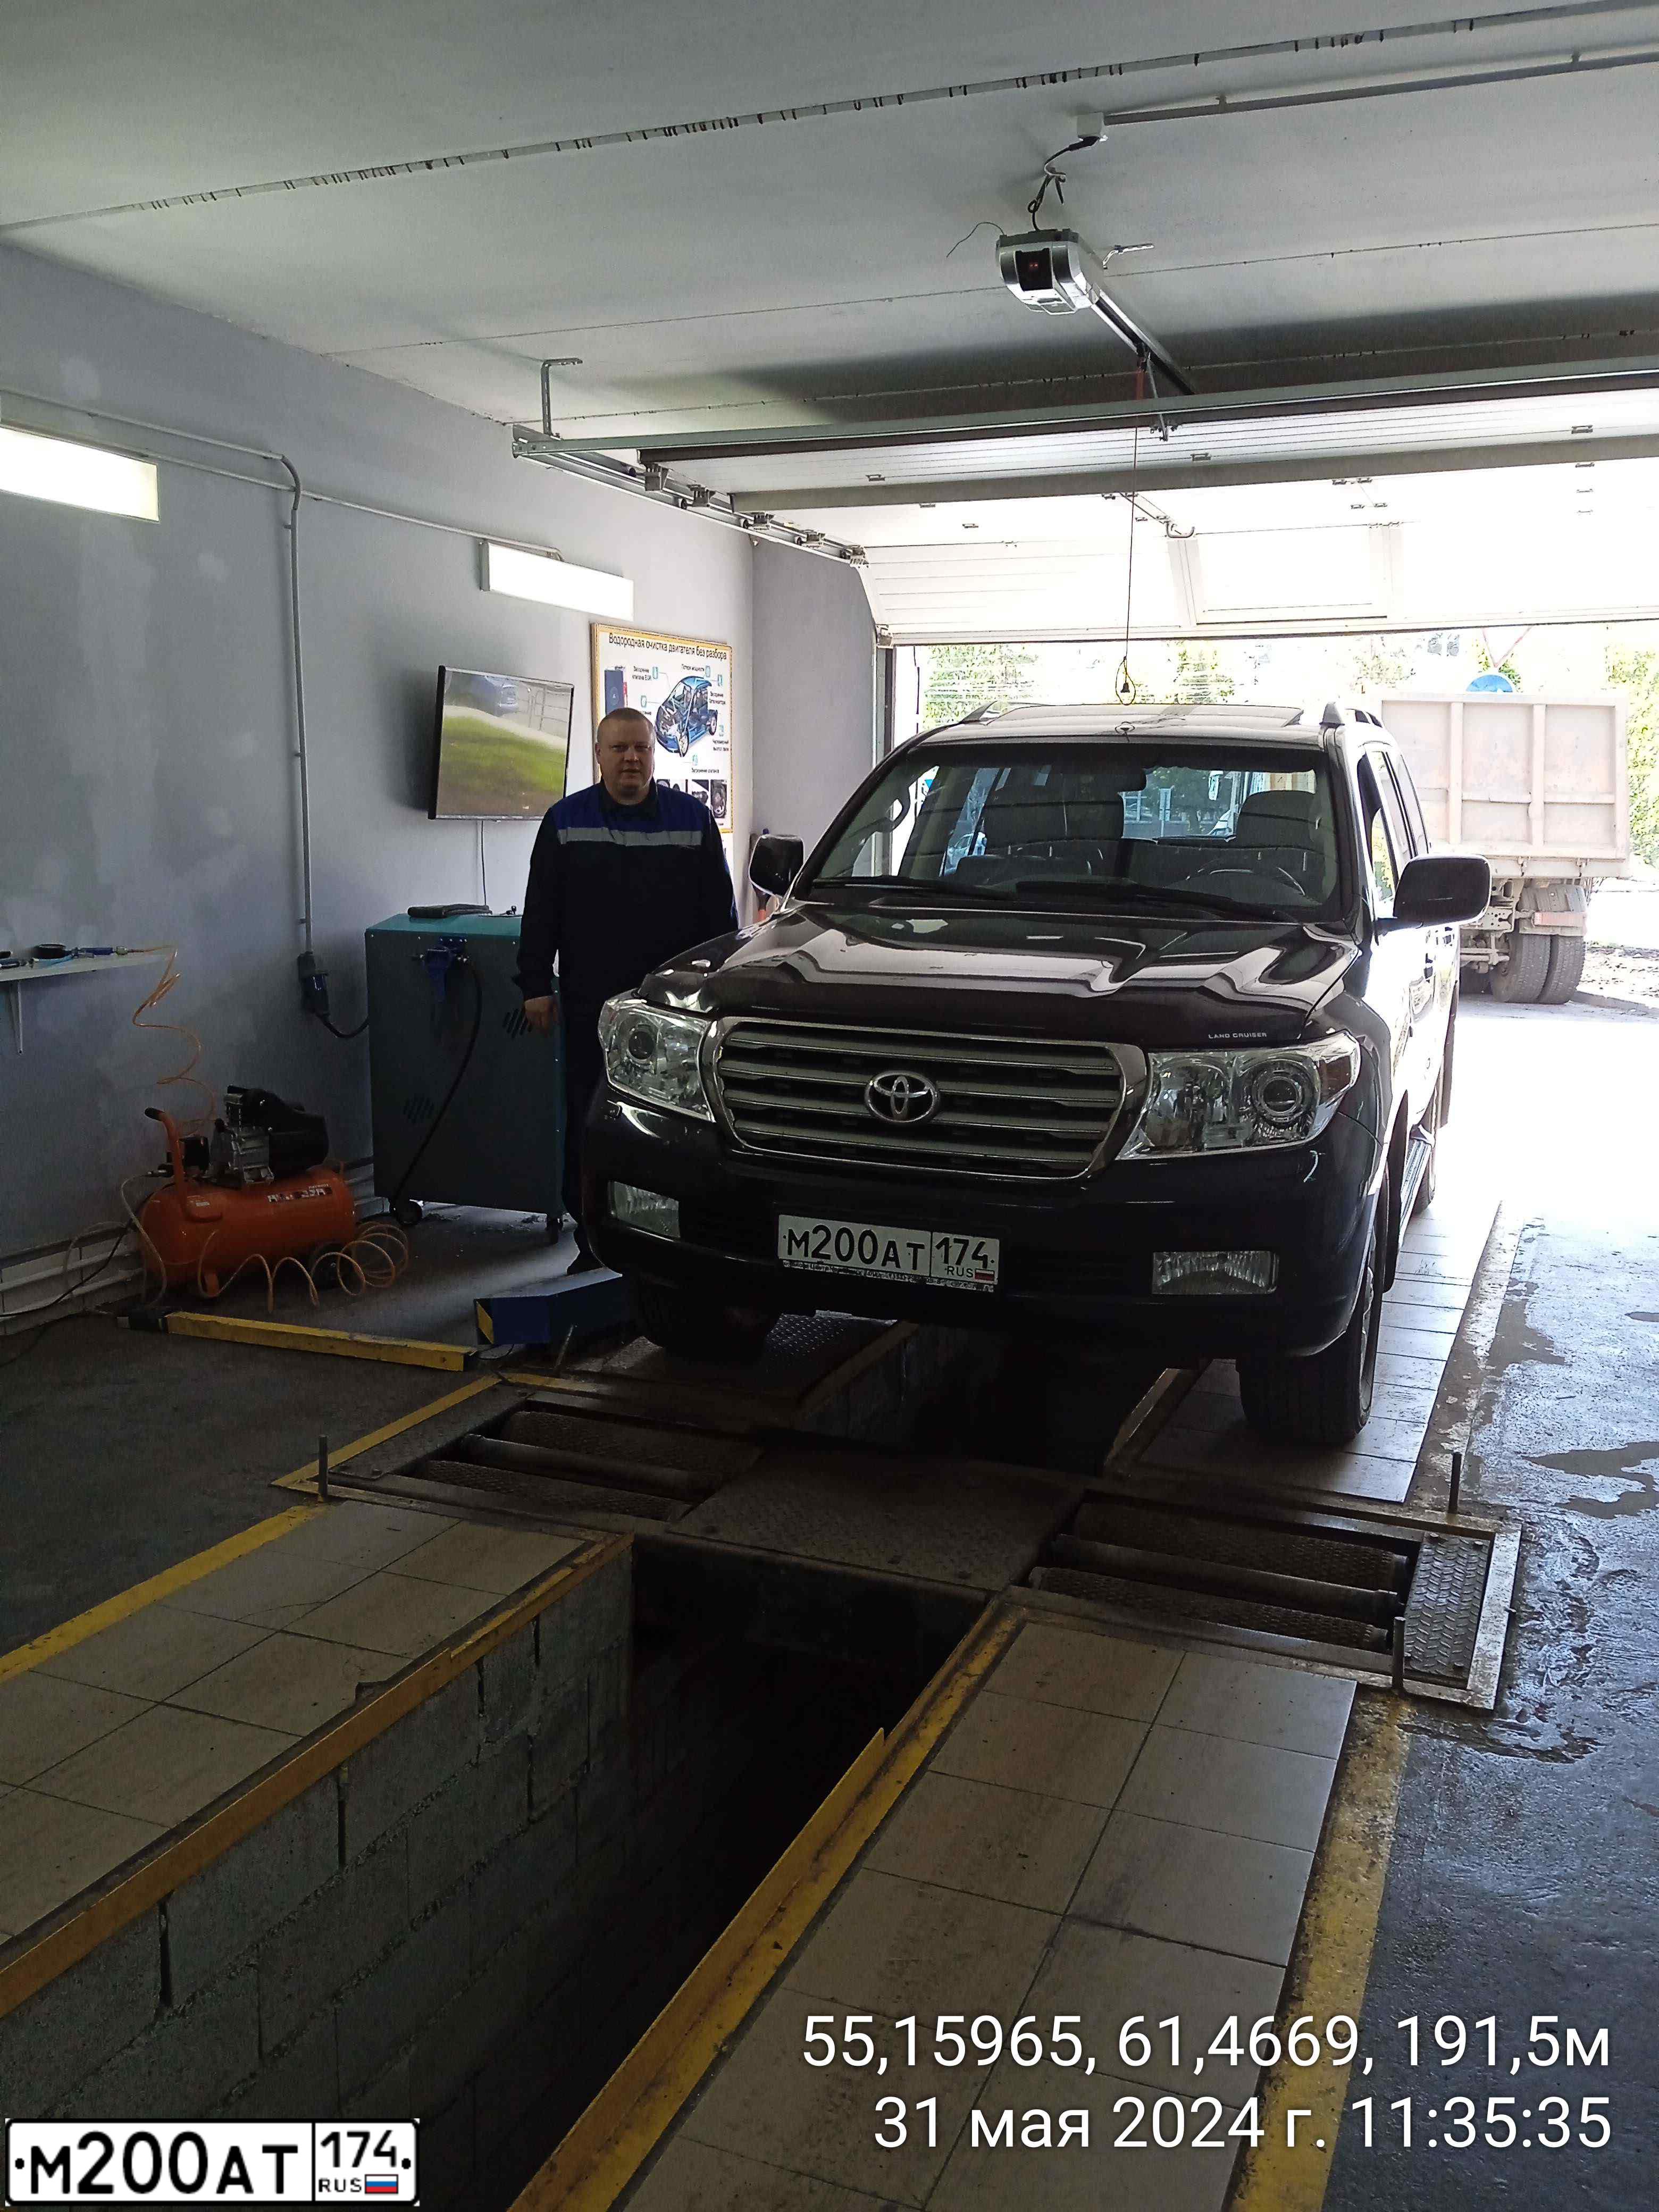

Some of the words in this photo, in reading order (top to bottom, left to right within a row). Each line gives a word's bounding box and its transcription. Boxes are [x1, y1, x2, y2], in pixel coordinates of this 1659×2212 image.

[609, 633, 645, 648] Водородная
[646, 641, 667, 651] очистка
[668, 644, 696, 655] двигателя
[696, 646, 705, 657] без
[706, 649, 727, 661] разбора
[787, 1224, 925, 1270] М200АТ
[935, 1237, 988, 1269] 174
[946, 1266, 974, 1278] RUS
